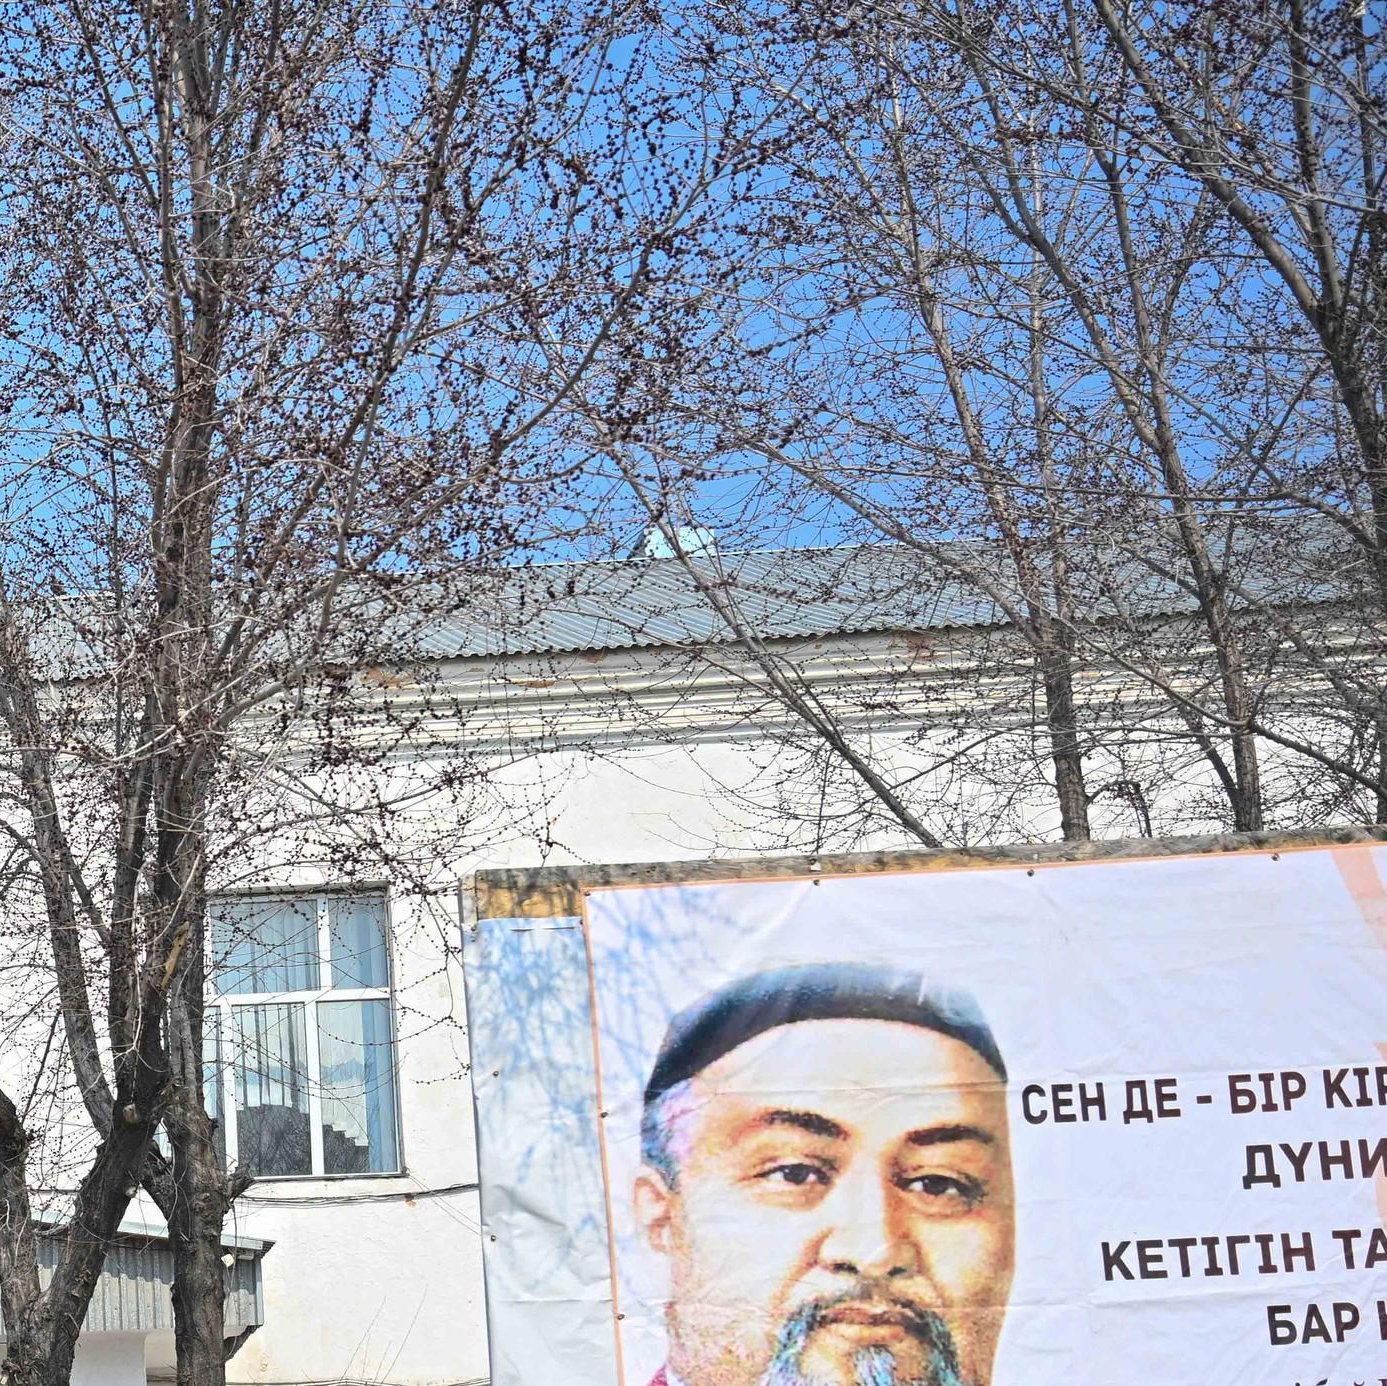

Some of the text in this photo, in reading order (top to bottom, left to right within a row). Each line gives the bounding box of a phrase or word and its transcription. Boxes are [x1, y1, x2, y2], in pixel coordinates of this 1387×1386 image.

[1021, 1082, 1107, 1125] СЕН
[1123, 1078, 1181, 1124] ДЕ
[1228, 1071, 1307, 1114] БІР
[1101, 1231, 1316, 1281] КЕТІГІН
[1267, 1302, 1360, 1346] БАР
